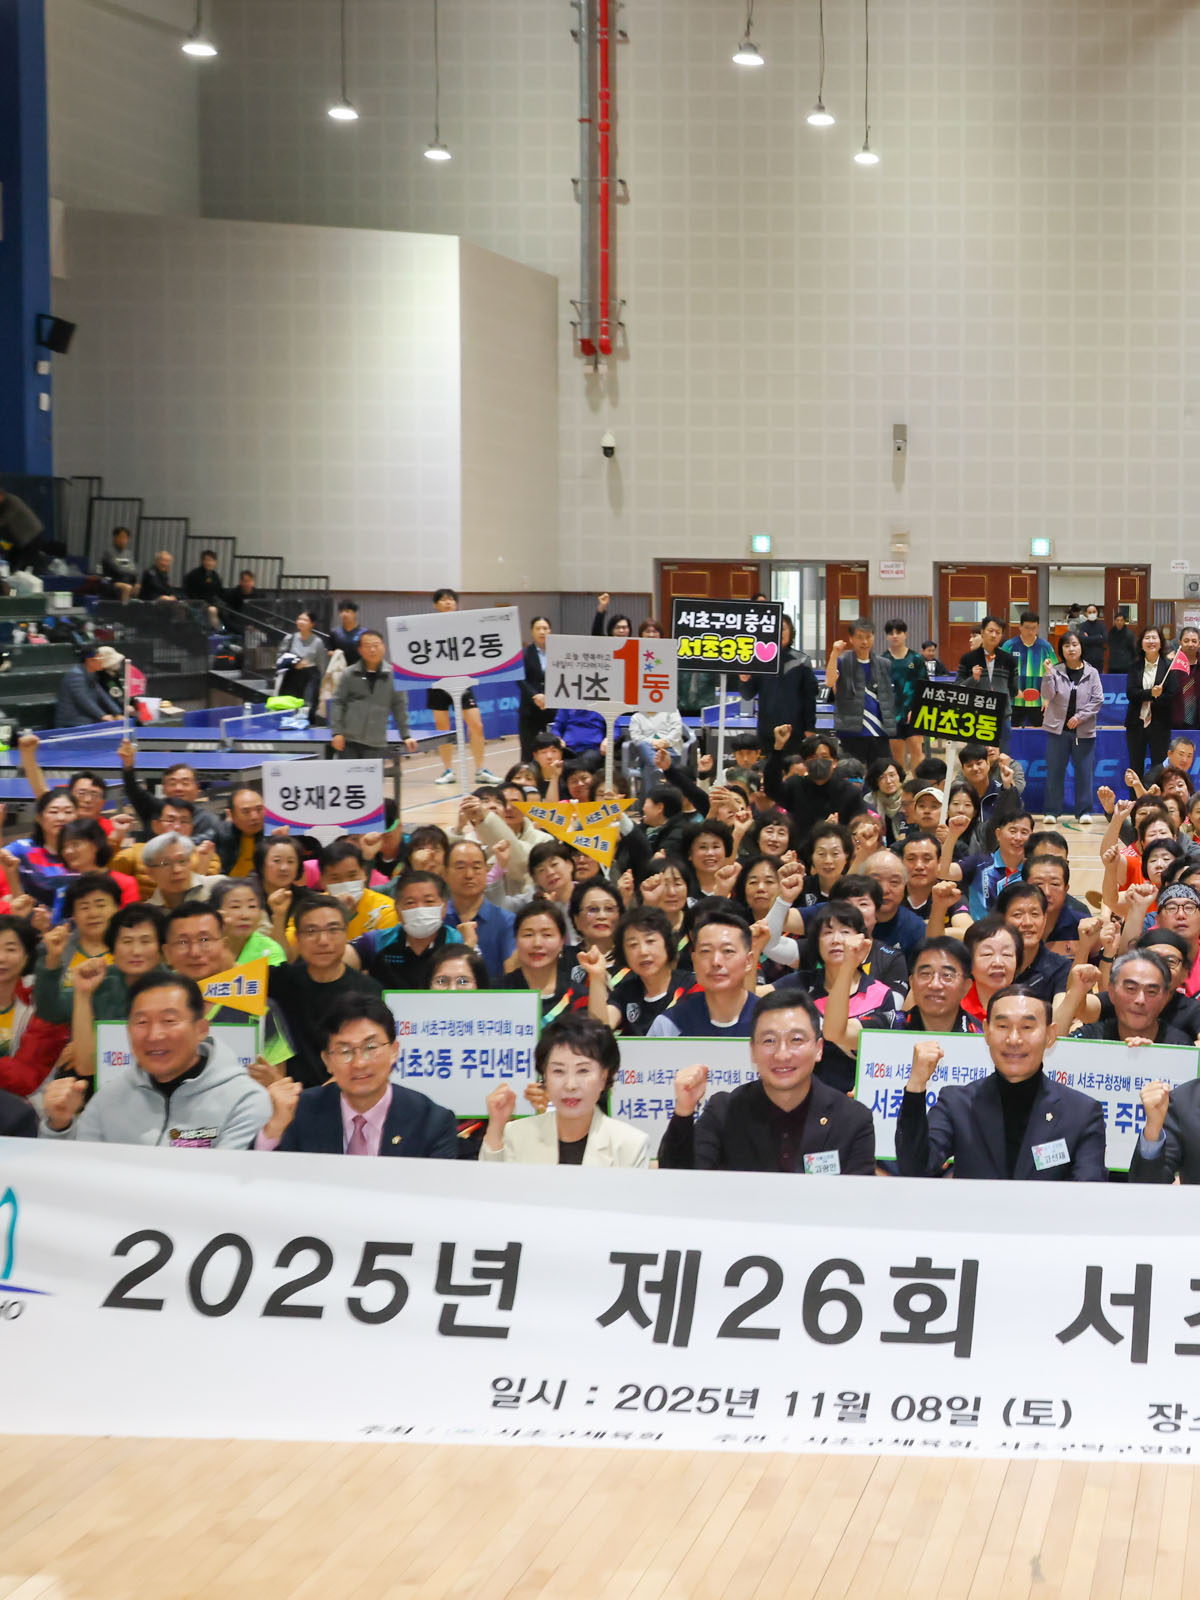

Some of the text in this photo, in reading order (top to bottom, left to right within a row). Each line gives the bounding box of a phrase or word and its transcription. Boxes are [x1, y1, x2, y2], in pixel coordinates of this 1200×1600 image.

[677, 609, 776, 633] 서초구의 중심
[408, 633, 503, 665] 양재2동
[677, 635, 755, 662] 서초3동
[922, 687, 997, 710] 서초구의 중심
[914, 705, 998, 741] 서초3동
[280, 785, 366, 811] 양재2동
[203, 975, 258, 997] 서초1동
[421, 1020, 473, 1036] 서초구청장배
[477, 1020, 512, 1036] 탁구대회
[460, 1048, 531, 1079] 주민센터
[616, 1068, 643, 1084] 제26회
[865, 1062, 892, 1079] 제26회
[1077, 1072, 1131, 1092] 서초구청장배
[100, 1229, 522, 1339] 2025년
[595, 1249, 980, 1358] 제26회
[490, 1376, 569, 1411] 일시
[614, 1383, 760, 1420] 2025년
[784, 1391, 871, 1423] 11월
[890, 1394, 983, 1427] 08일
[1003, 1397, 1074, 1429] (토)
